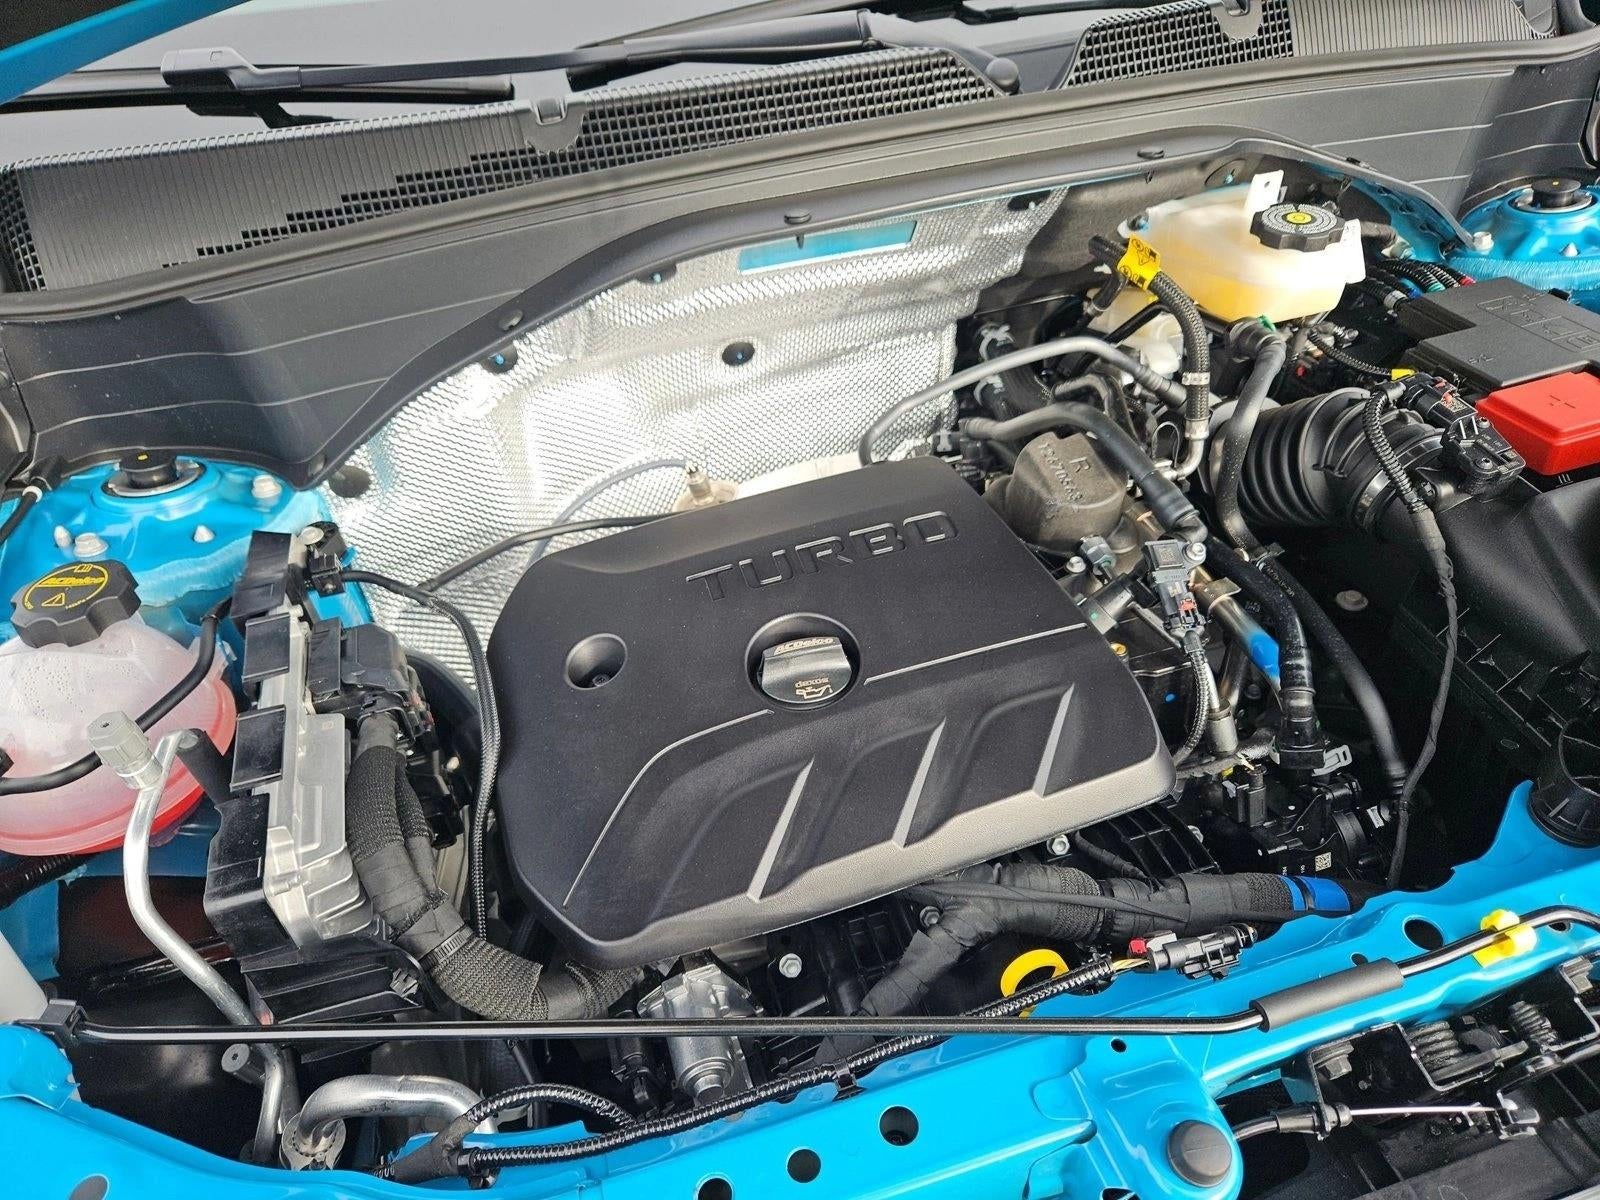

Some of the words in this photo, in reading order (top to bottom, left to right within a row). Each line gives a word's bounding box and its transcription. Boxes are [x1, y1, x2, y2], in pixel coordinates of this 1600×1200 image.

[685, 510, 958, 601] TURBO
[774, 638, 834, 656] ACDelco
[794, 677, 829, 688] dexos
